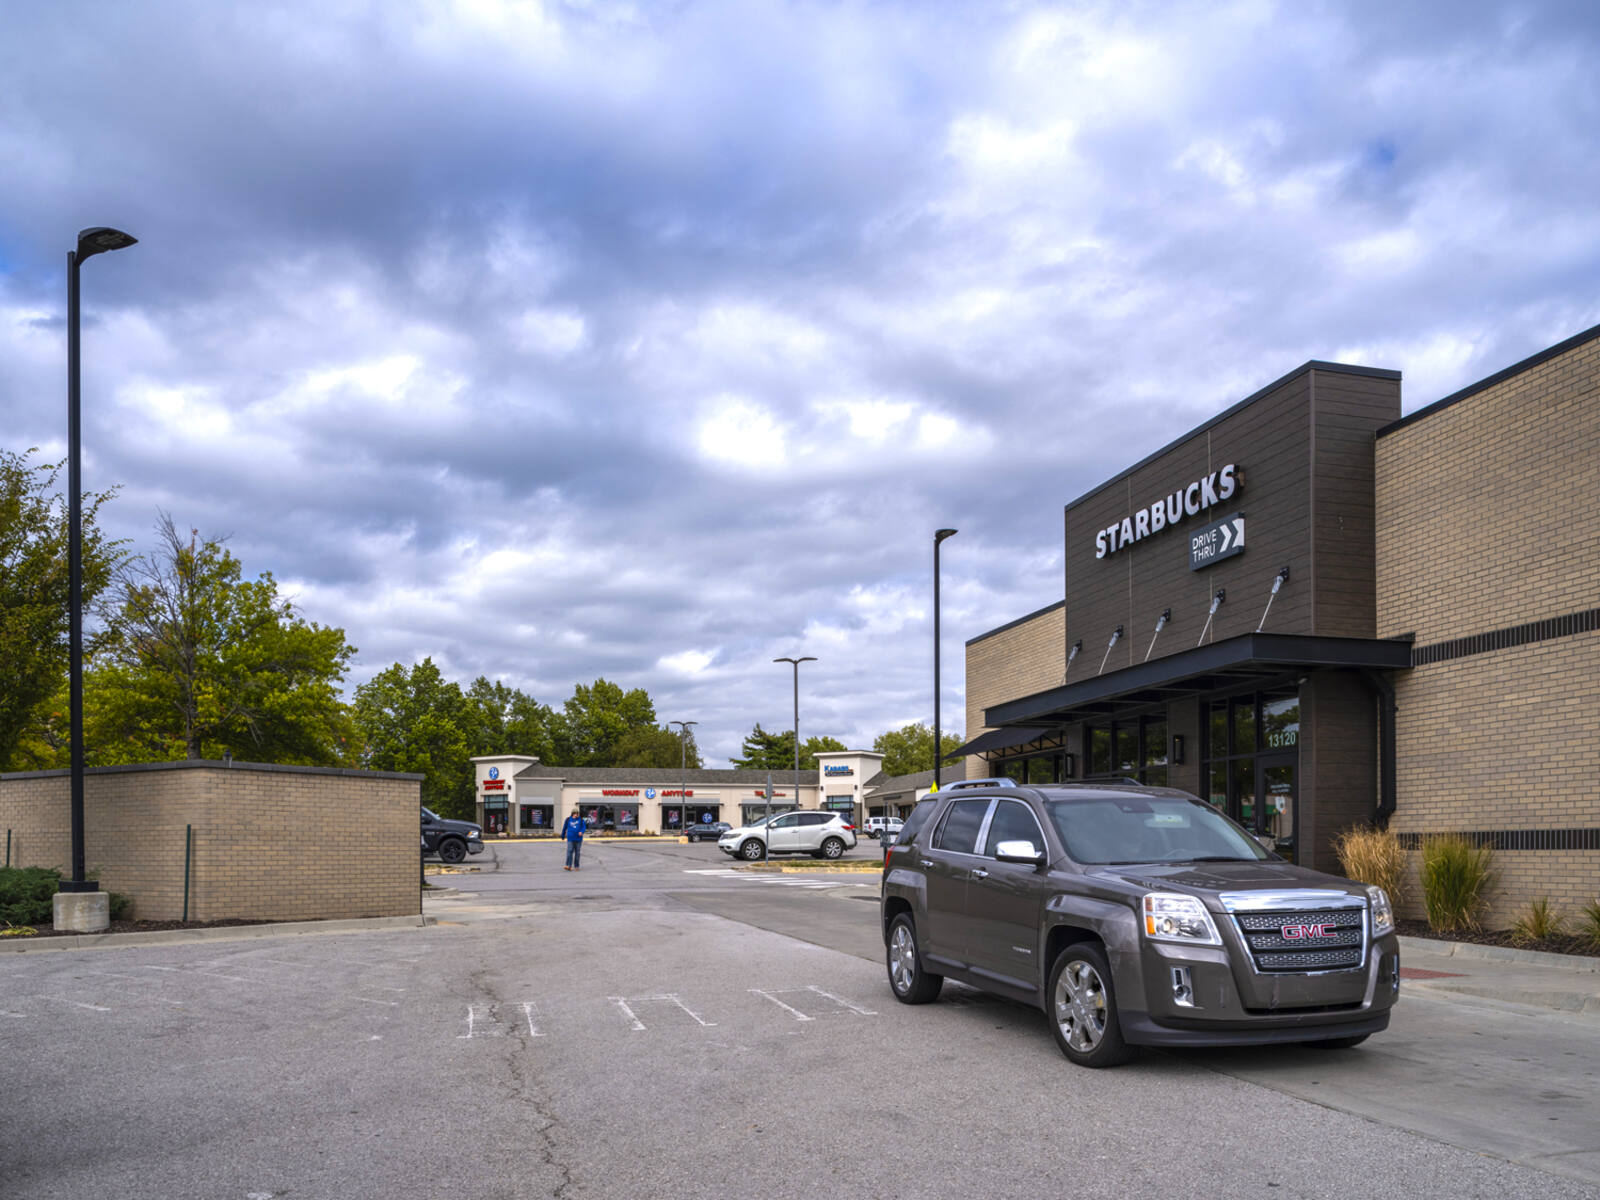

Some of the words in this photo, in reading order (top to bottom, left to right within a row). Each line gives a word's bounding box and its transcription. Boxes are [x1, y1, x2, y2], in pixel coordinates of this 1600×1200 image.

[1096, 464, 1235, 559] STARBUCKS
[1192, 529, 1216, 550] DRIVE
[1192, 543, 1216, 562] THRU
[1269, 732, 1296, 748] 13120
[1281, 923, 1337, 939] GMC
